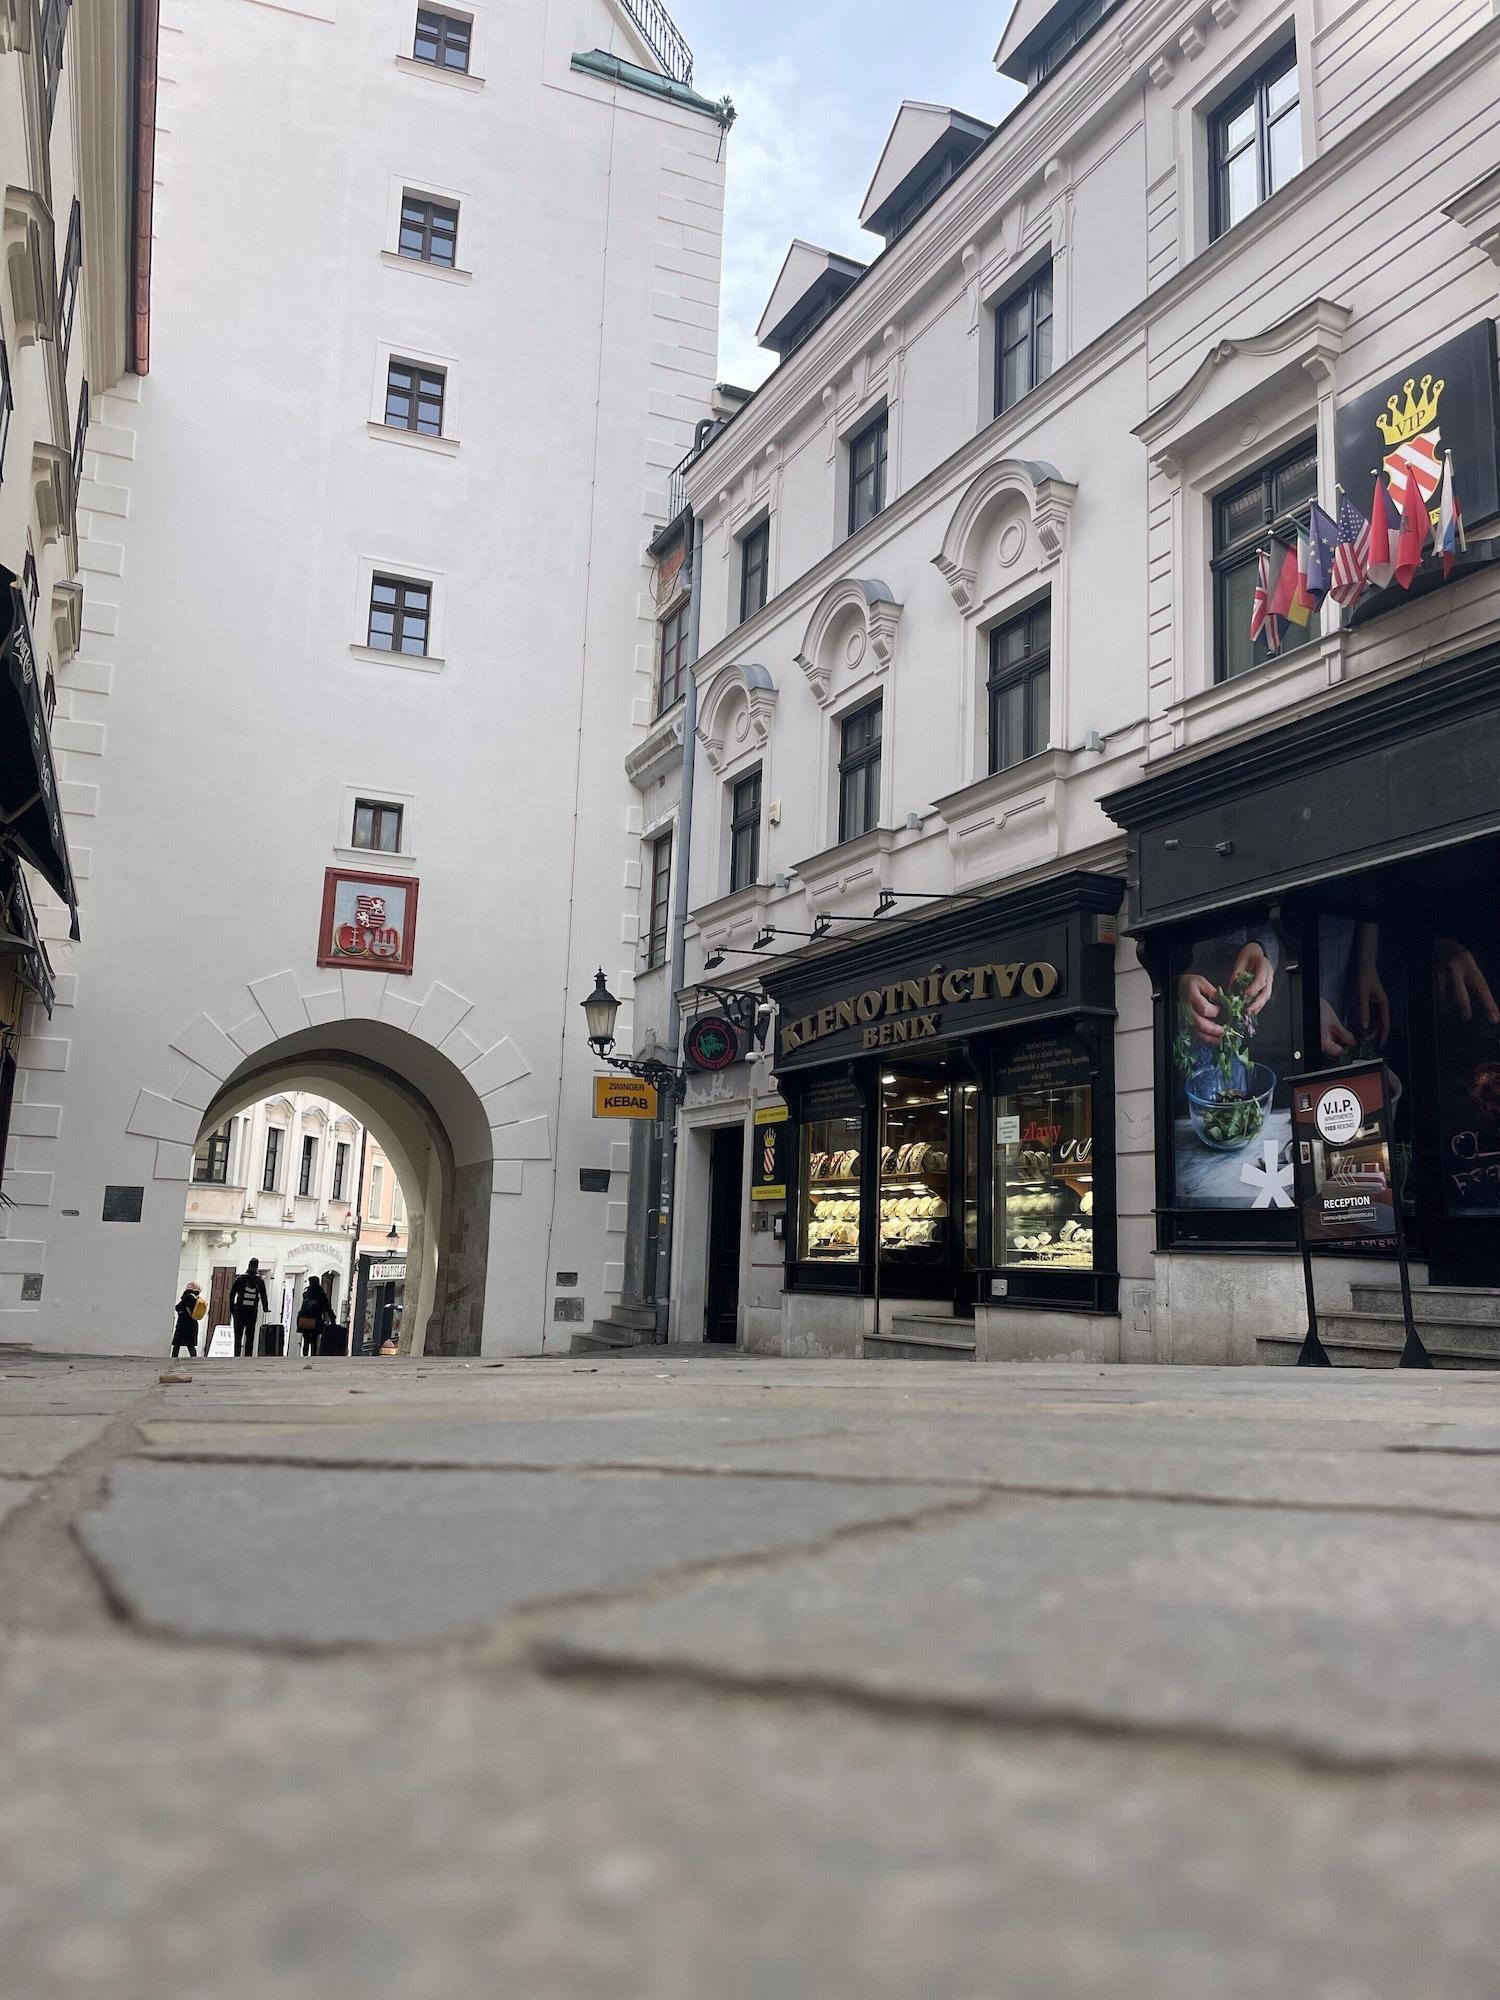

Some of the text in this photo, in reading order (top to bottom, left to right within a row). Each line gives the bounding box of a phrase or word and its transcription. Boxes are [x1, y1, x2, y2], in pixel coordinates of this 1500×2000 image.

[1396, 410, 1426, 437] VIP
[780, 961, 1059, 1055] KLENOTNÍCTVO
[863, 1013, 941, 1049] BENIX
[608, 1082, 645, 1092] ZWINGER
[604, 1096, 648, 1110] KEBAB
[1323, 1099, 1353, 1115] V.I.P.
[1324, 1112, 1354, 1121] APARTMENTS
[1337, 1122, 1355, 1130] ROOMS
[1324, 1195, 1371, 1209] RECEPTION
